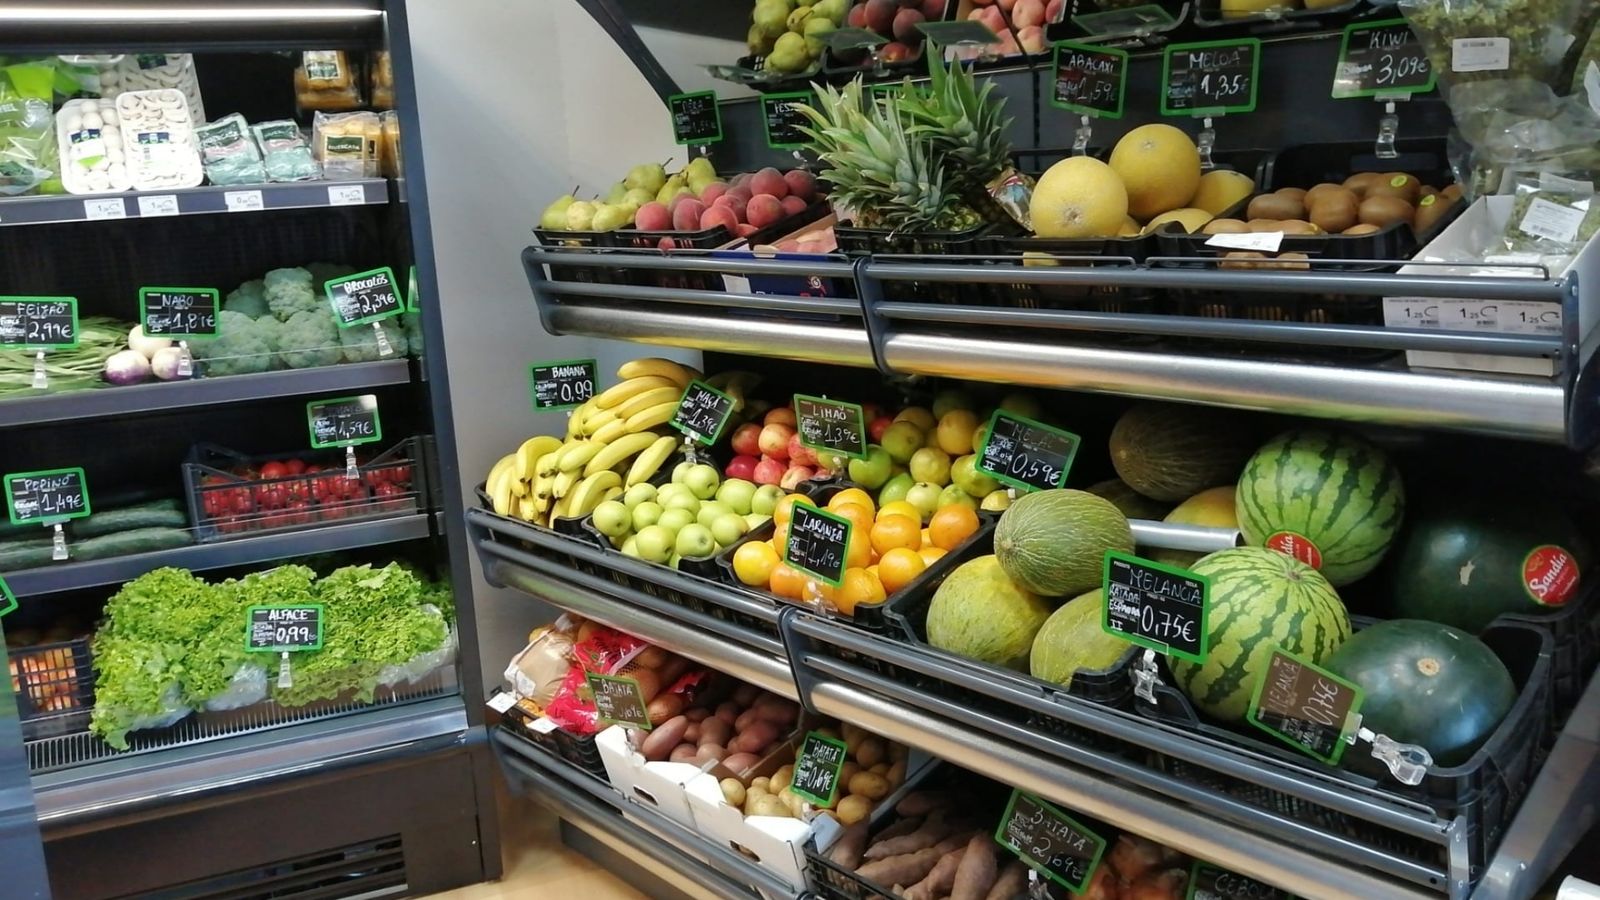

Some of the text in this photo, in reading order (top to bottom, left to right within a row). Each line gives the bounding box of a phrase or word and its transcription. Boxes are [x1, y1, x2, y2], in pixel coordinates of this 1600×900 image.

[1369, 31, 1408, 49] KIWI
[1376, 54, 1429, 84] 3,09€
[161, 294, 194, 308] NABO
[359, 293, 396, 313] 2,39€
[28, 321, 74, 341] 2,99€
[551, 365, 586, 379] BANANA
[560, 380, 593, 402] 0,99
[1012, 453, 1063, 486] 0,59€
[24, 475, 70, 492] PEPINO
[41, 494, 84, 513] 1,49€
[1129, 567, 1202, 605] MELANCIA
[268, 609, 308, 621] ALFACE
[1141, 604, 1197, 642] 0,75€
[276, 626, 310, 644] 0,99
[1301, 678, 1340, 726] 0,75€
[812, 741, 839, 762] BATATA
